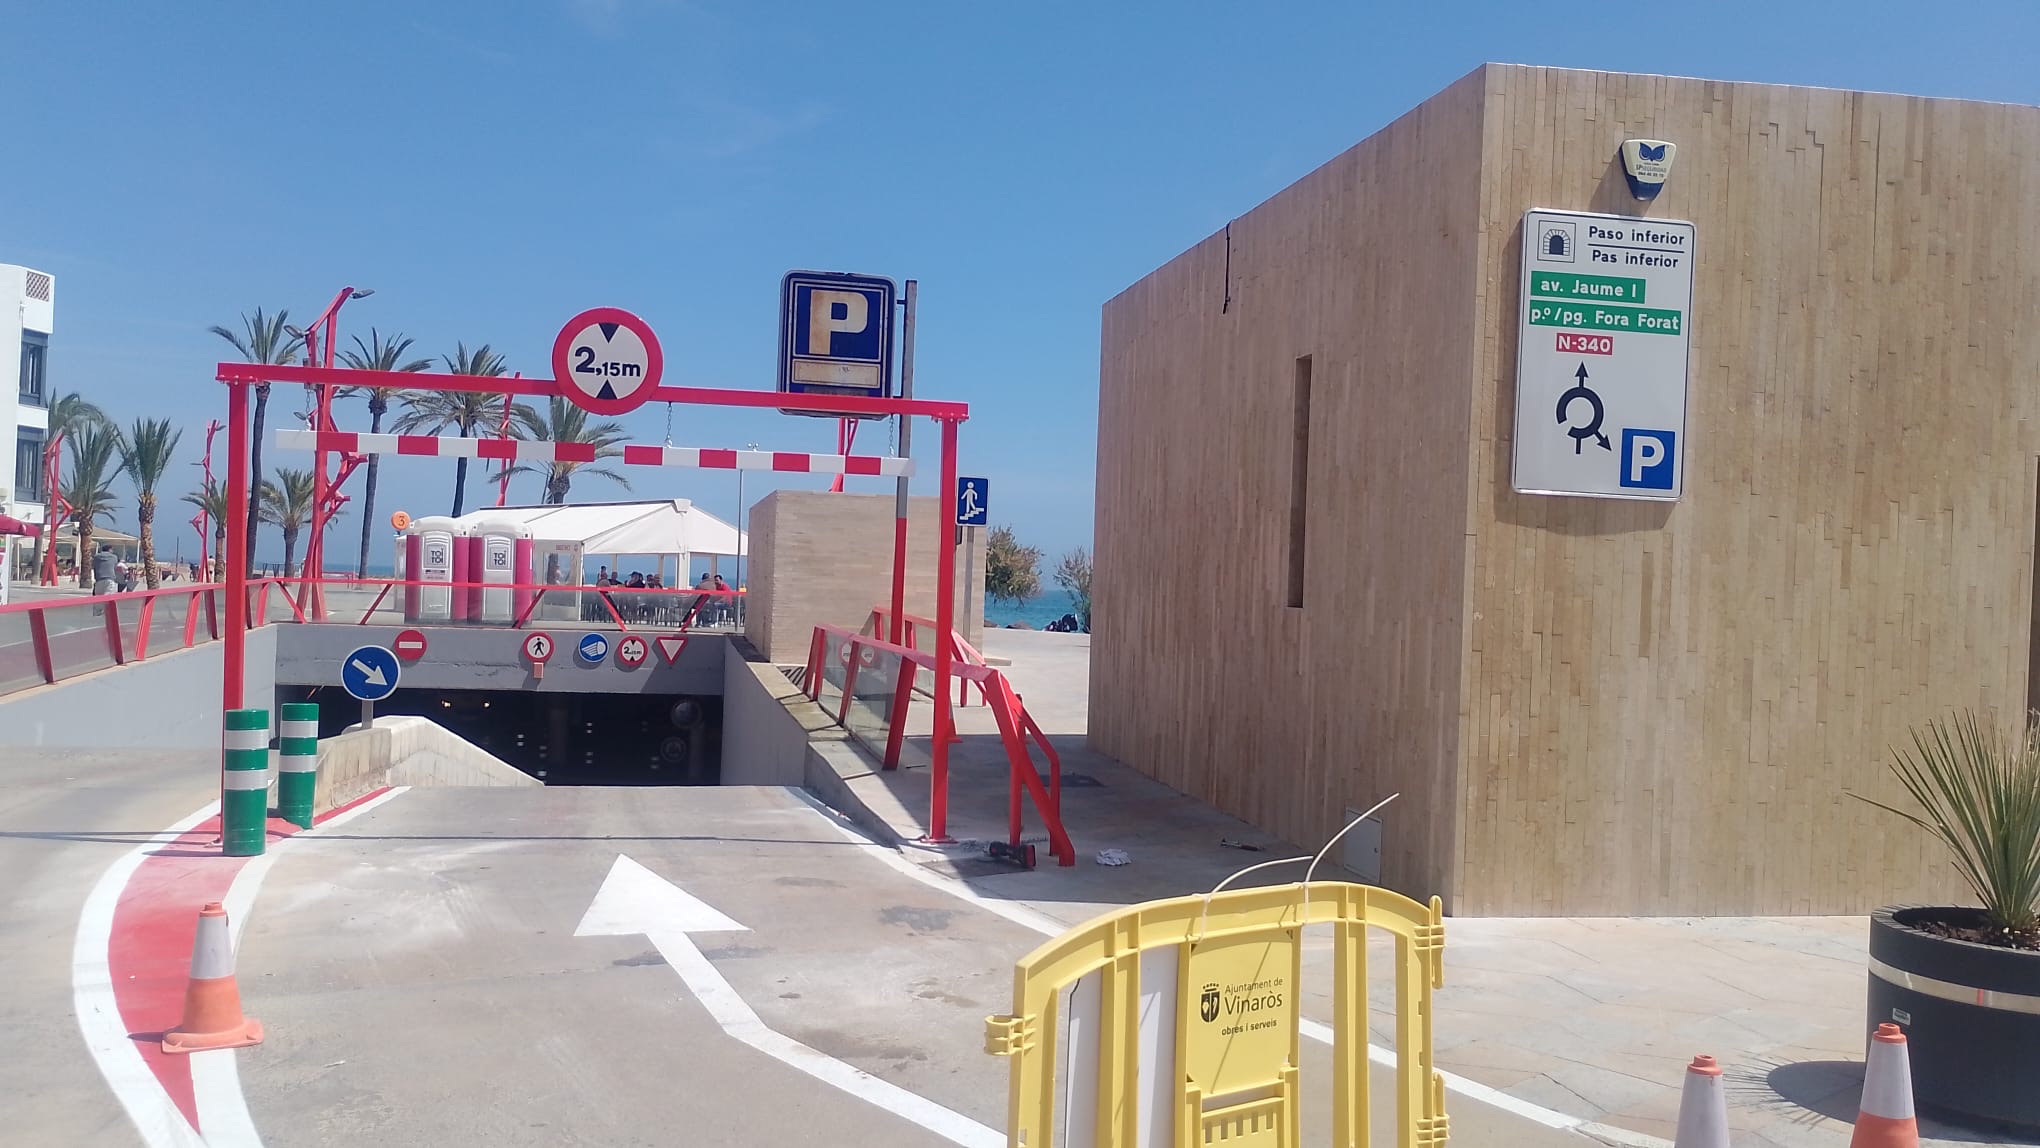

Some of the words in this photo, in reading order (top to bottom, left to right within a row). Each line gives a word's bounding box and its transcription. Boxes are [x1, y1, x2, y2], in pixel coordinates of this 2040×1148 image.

[1588, 225, 1624, 240] Paso
[1631, 229, 1685, 245] inferior
[1592, 249, 1618, 263] Pas
[1625, 252, 1679, 268] inferior
[1540, 280, 1564, 293] av.
[1571, 279, 1624, 297] Jaume
[808, 289, 869, 355] P
[1595, 310, 1630, 326] Fora
[1637, 313, 1680, 330] Forat
[1558, 335, 1612, 353] N-340
[574, 346, 641, 378] 2,15m
[1630, 435, 1665, 482] P
[398, 515, 405, 527] 3
[1224, 980, 1272, 996] Ajuntament
[1273, 977, 1284, 987] de
[1224, 990, 1283, 1016] Vinaròs
[1221, 1025, 1244, 1036] obres
[1250, 1018, 1277, 1031] serveis
